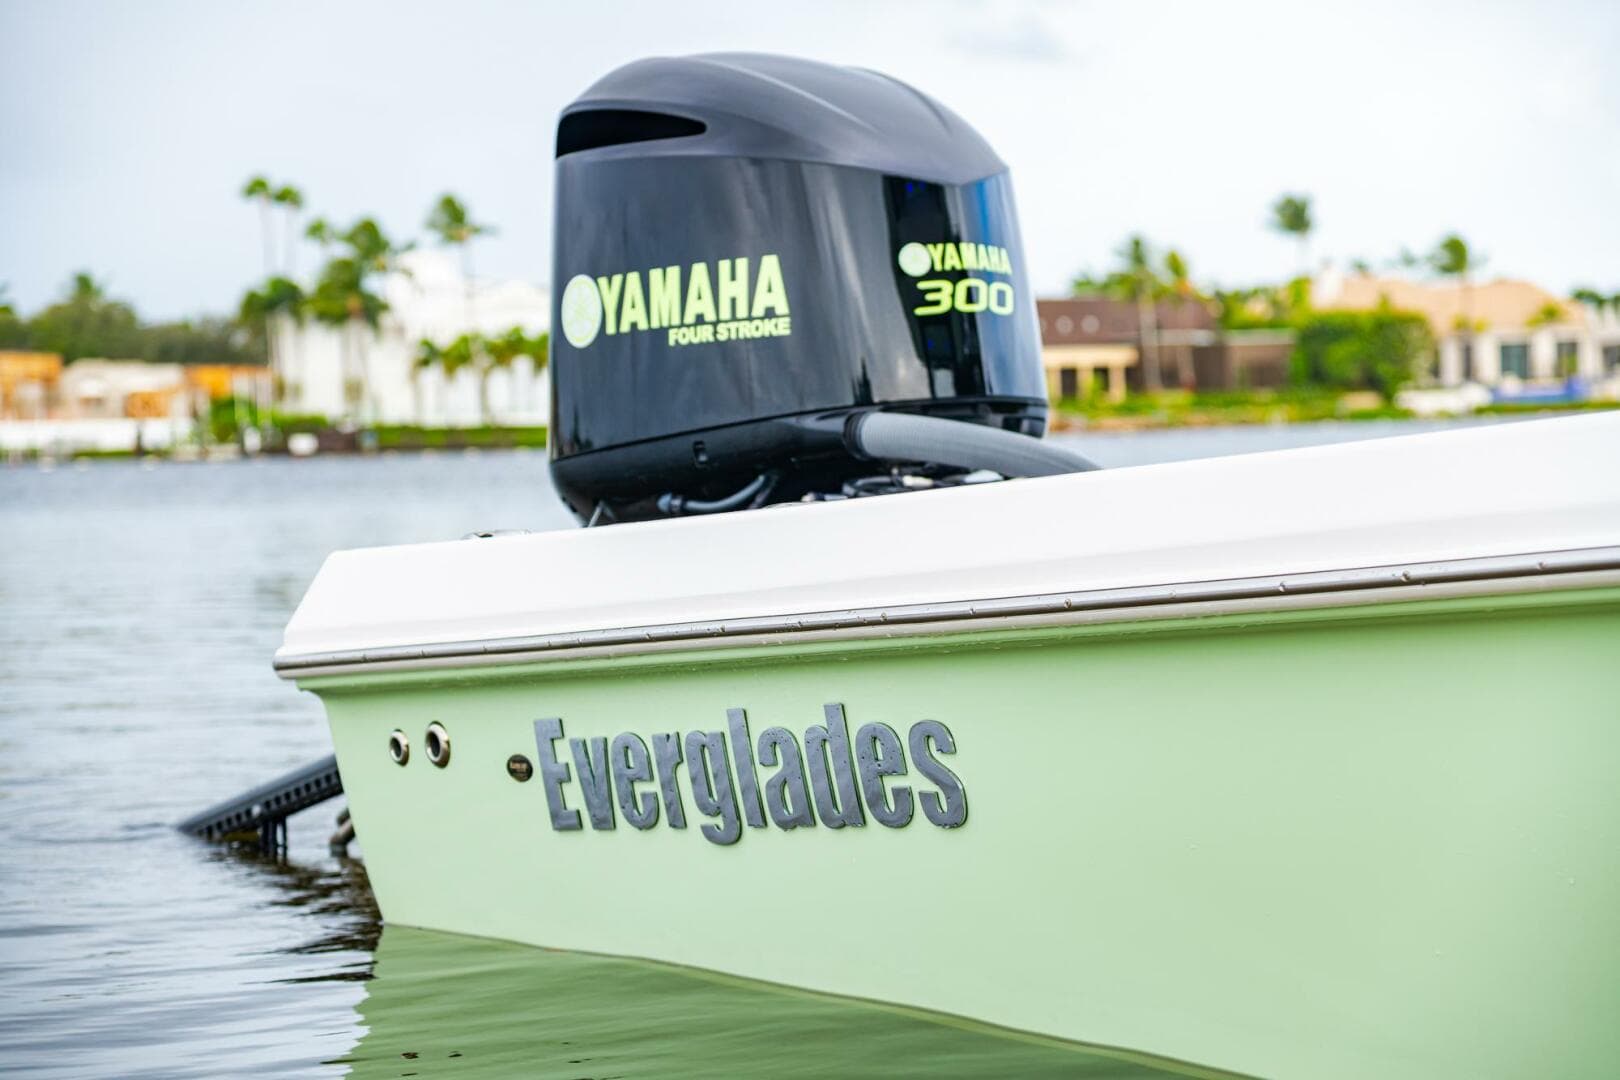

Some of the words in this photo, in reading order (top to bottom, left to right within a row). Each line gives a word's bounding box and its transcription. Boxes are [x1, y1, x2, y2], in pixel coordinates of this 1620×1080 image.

[926, 242, 1013, 275] YAMAHA
[597, 254, 790, 335] YAMAHA
[914, 278, 1014, 316] 300
[668, 325, 715, 346] FOUR
[716, 317, 791, 341] STROKE
[533, 702, 968, 846] Everglades
